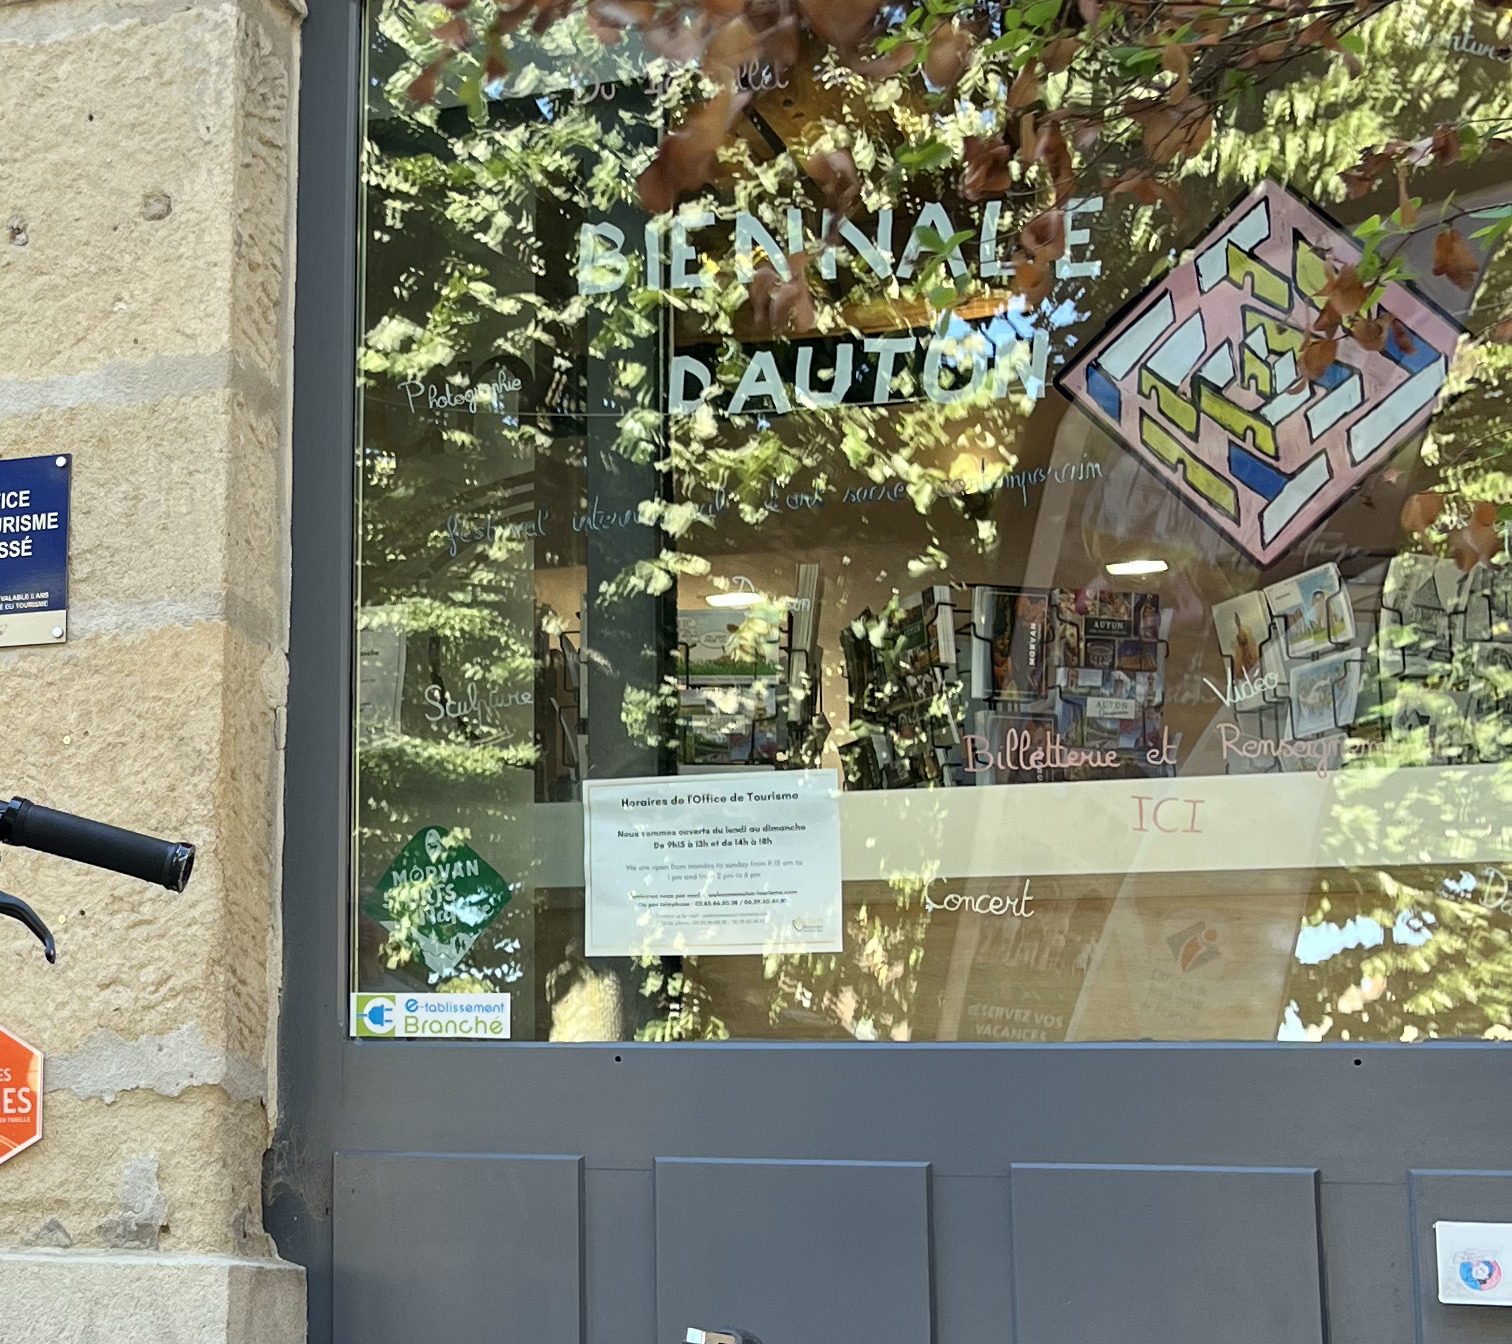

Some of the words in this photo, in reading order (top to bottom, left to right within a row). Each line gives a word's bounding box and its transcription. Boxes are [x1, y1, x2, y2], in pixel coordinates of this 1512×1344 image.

[577, 196, 1104, 295] BIENNALE
[1202, 666, 1278, 707] Vidéo
[962, 727, 1121, 772] Billetterie
[1146, 726, 1178, 765] et
[621, 797, 668, 808] Horaires
[729, 792, 744, 803] de
[746, 791, 799, 802] Tourisme
[1130, 795, 1206, 834] ICI
[392, 859, 479, 886] MORVAN
[924, 876, 1034, 918] Concert
[404, 1015, 504, 1035] Branché
[405, 998, 505, 1013] e-tablissement
